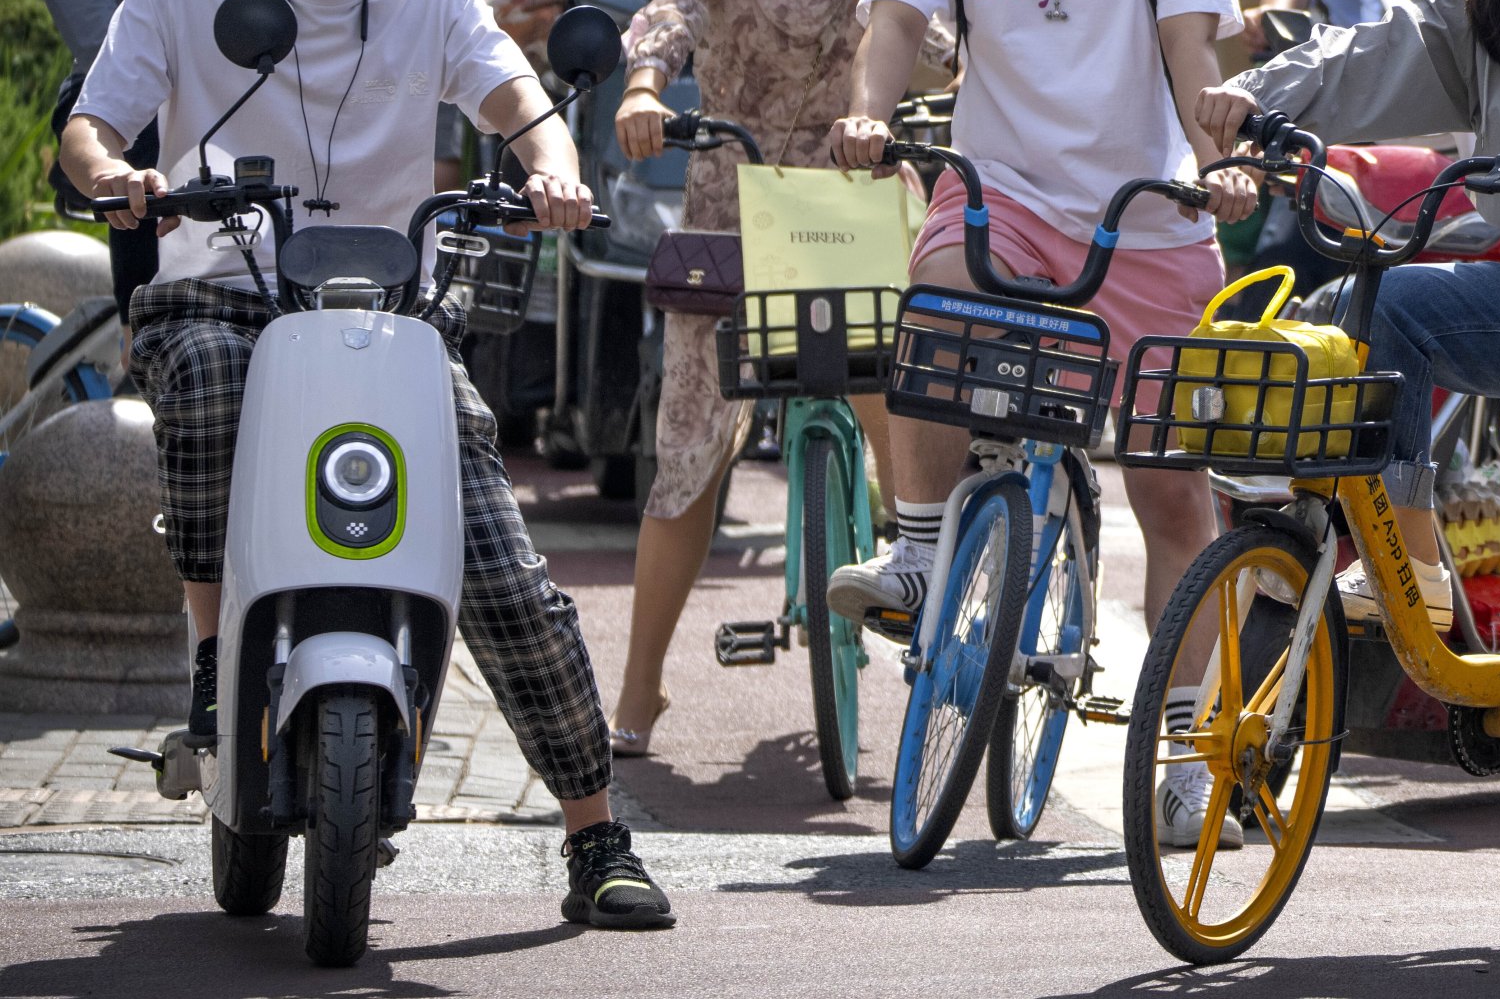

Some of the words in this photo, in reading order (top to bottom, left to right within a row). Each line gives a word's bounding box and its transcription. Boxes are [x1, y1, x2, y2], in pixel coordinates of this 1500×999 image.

[790, 231, 855, 244] FERRERO
[1004, 311, 1037, 326] 更省钱
[1038, 317, 1070, 332] 更好用
